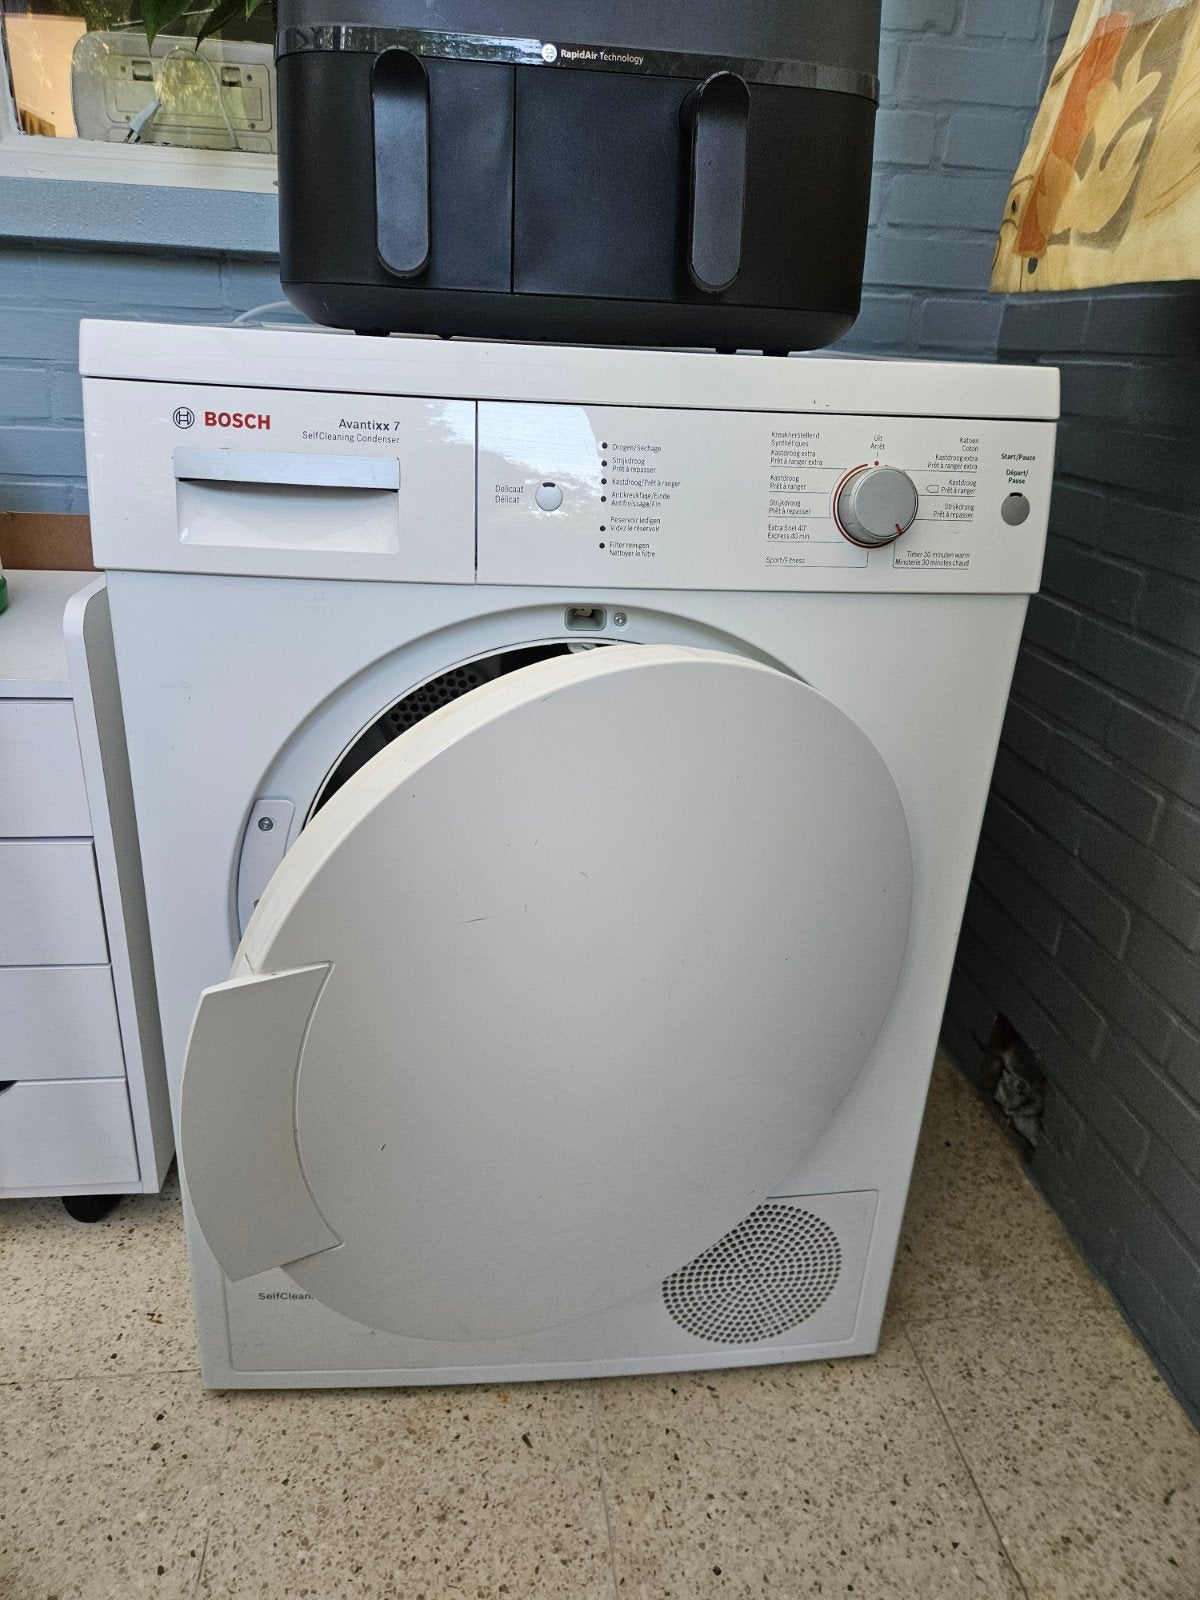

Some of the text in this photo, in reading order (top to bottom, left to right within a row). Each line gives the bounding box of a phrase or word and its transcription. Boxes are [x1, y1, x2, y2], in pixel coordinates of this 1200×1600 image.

[560, 49, 644, 65] RapidAir Technology
[204, 411, 271, 430] BOSCH
[338, 418, 400, 431] Avantixx 7
[302, 431, 400, 444] SelfCleaning Condenser
[770, 449, 800, 458] Kastdroog
[612, 456, 646, 467] Strijkdroog
[788, 459, 807, 467] ranger
[935, 454, 963, 463] Kastdroog
[630, 466, 657, 474] repasser
[1006, 469, 1029, 478] Départ/
[770, 474, 800, 483] Kastdroog
[1008, 477, 1026, 485] Pause
[661, 480, 681, 488] ranger
[769, 482, 782, 490] Prêt
[787, 484, 807, 492] ranger
[948, 480, 977, 488] Kastdroog
[495, 484, 524, 494] Delicaat
[940, 486, 954, 494] Prêt
[957, 488, 976, 496] ranger
[769, 500, 801, 508] Strijkdroog
[944, 503, 975, 512] Strijkdroog
[933, 510, 946, 518] Prêt
[610, 516, 661, 526] Reservoir ledigen
[610, 524, 627, 532] Videz
[768, 523, 784, 531] Extra
[767, 532, 790, 541] Express
[609, 541, 650, 551] Filter reinigen
[609, 549, 635, 558] Nettoyer
[641, 550, 656, 558] filtre
[907, 550, 923, 558] Timer
[765, 556, 806, 565] Sport/Fitness
[921, 559, 930, 567] 30
[258, 1292, 315, 1301] SelfClean
